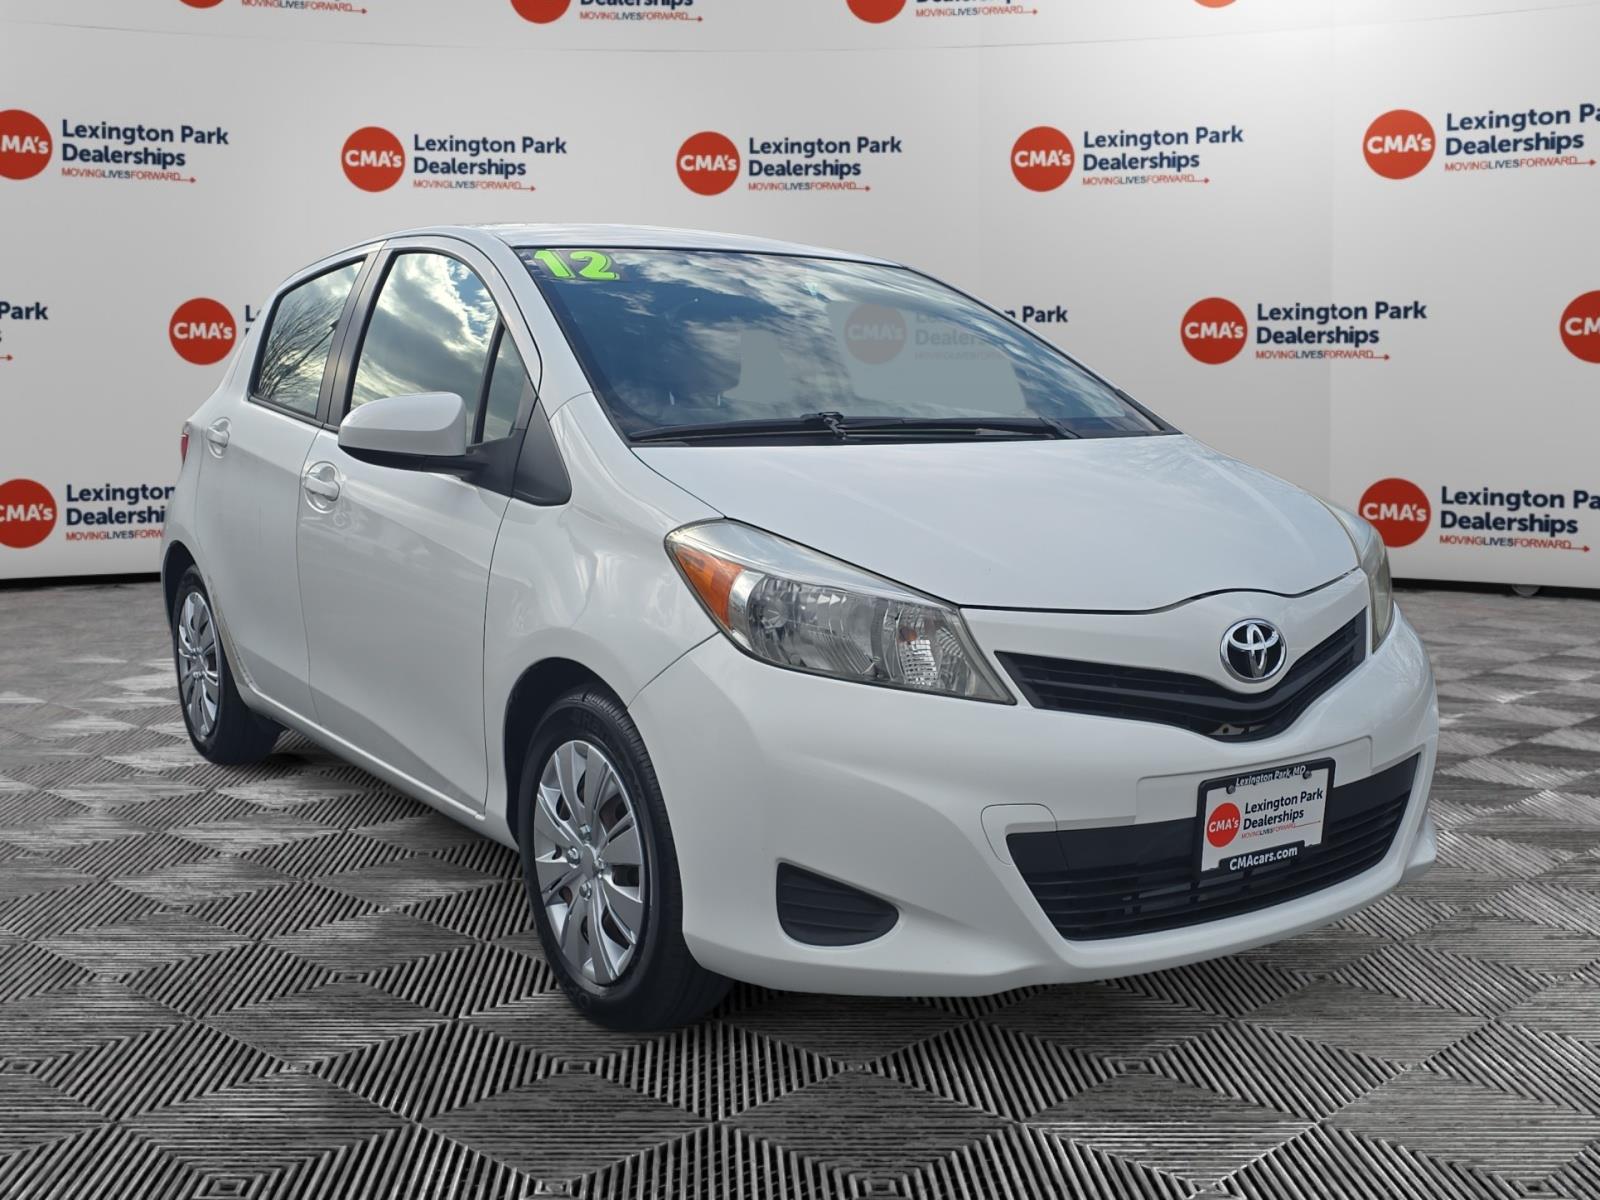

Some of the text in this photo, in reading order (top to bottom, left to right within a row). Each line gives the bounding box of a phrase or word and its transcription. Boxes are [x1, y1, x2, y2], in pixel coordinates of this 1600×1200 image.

[1446, 108, 1571, 132] Lexington
[62, 119, 229, 145] Lexington Park
[1083, 125, 1244, 151] Lexington Park
[1, 134, 49, 155] MA's
[414, 134, 568, 157] Lexington Park
[749, 136, 902, 158] Lexington Park
[1367, 133, 1432, 154] CMA's
[1445, 131, 1584, 155] Dealerships
[61, 143, 186, 169] Dealerships
[345, 149, 402, 169] CMA's
[680, 154, 737, 172] CMA's
[1014, 149, 1072, 168] CMA's
[1083, 150, 1200, 172] Dealerships
[1444, 156, 1578, 172] MOVINGLIVESFORWARD
[61, 167, 181, 181] MOVINGLIVESFORWARD
[413, 157, 527, 179] Dealerships
[748, 159, 861, 180] Dealerships
[534, 249, 620, 280] 12
[0, 301, 49, 320] Park
[1022, 305, 1069, 323] Park
[1257, 301, 1427, 325] Lexington Park
[173, 321, 233, 340] CMA's
[1184, 322, 1244, 340] CMA's
[1256, 326, 1379, 348] Dealerships
[1255, 350, 1374, 360] MOVINGLIVESFORWARD
[1441, 486, 1600, 511] Lexington Pa
[66, 505, 165, 526] Dealershi
[1362, 502, 1427, 522] CMA's
[1440, 510, 1578, 537] Dealerships
[66, 529, 162, 541] MOVINGLIVESFORW
[1439, 534, 1572, 549] MOVINGLIVESFORWARD
[1236, 773, 1273, 786] Lexington
[1245, 788, 1323, 814] Lexington Park
[1208, 818, 1239, 834] CMA's
[1243, 808, 1304, 830] Dealerships
[1229, 846, 1298, 871] CMAcars.com
